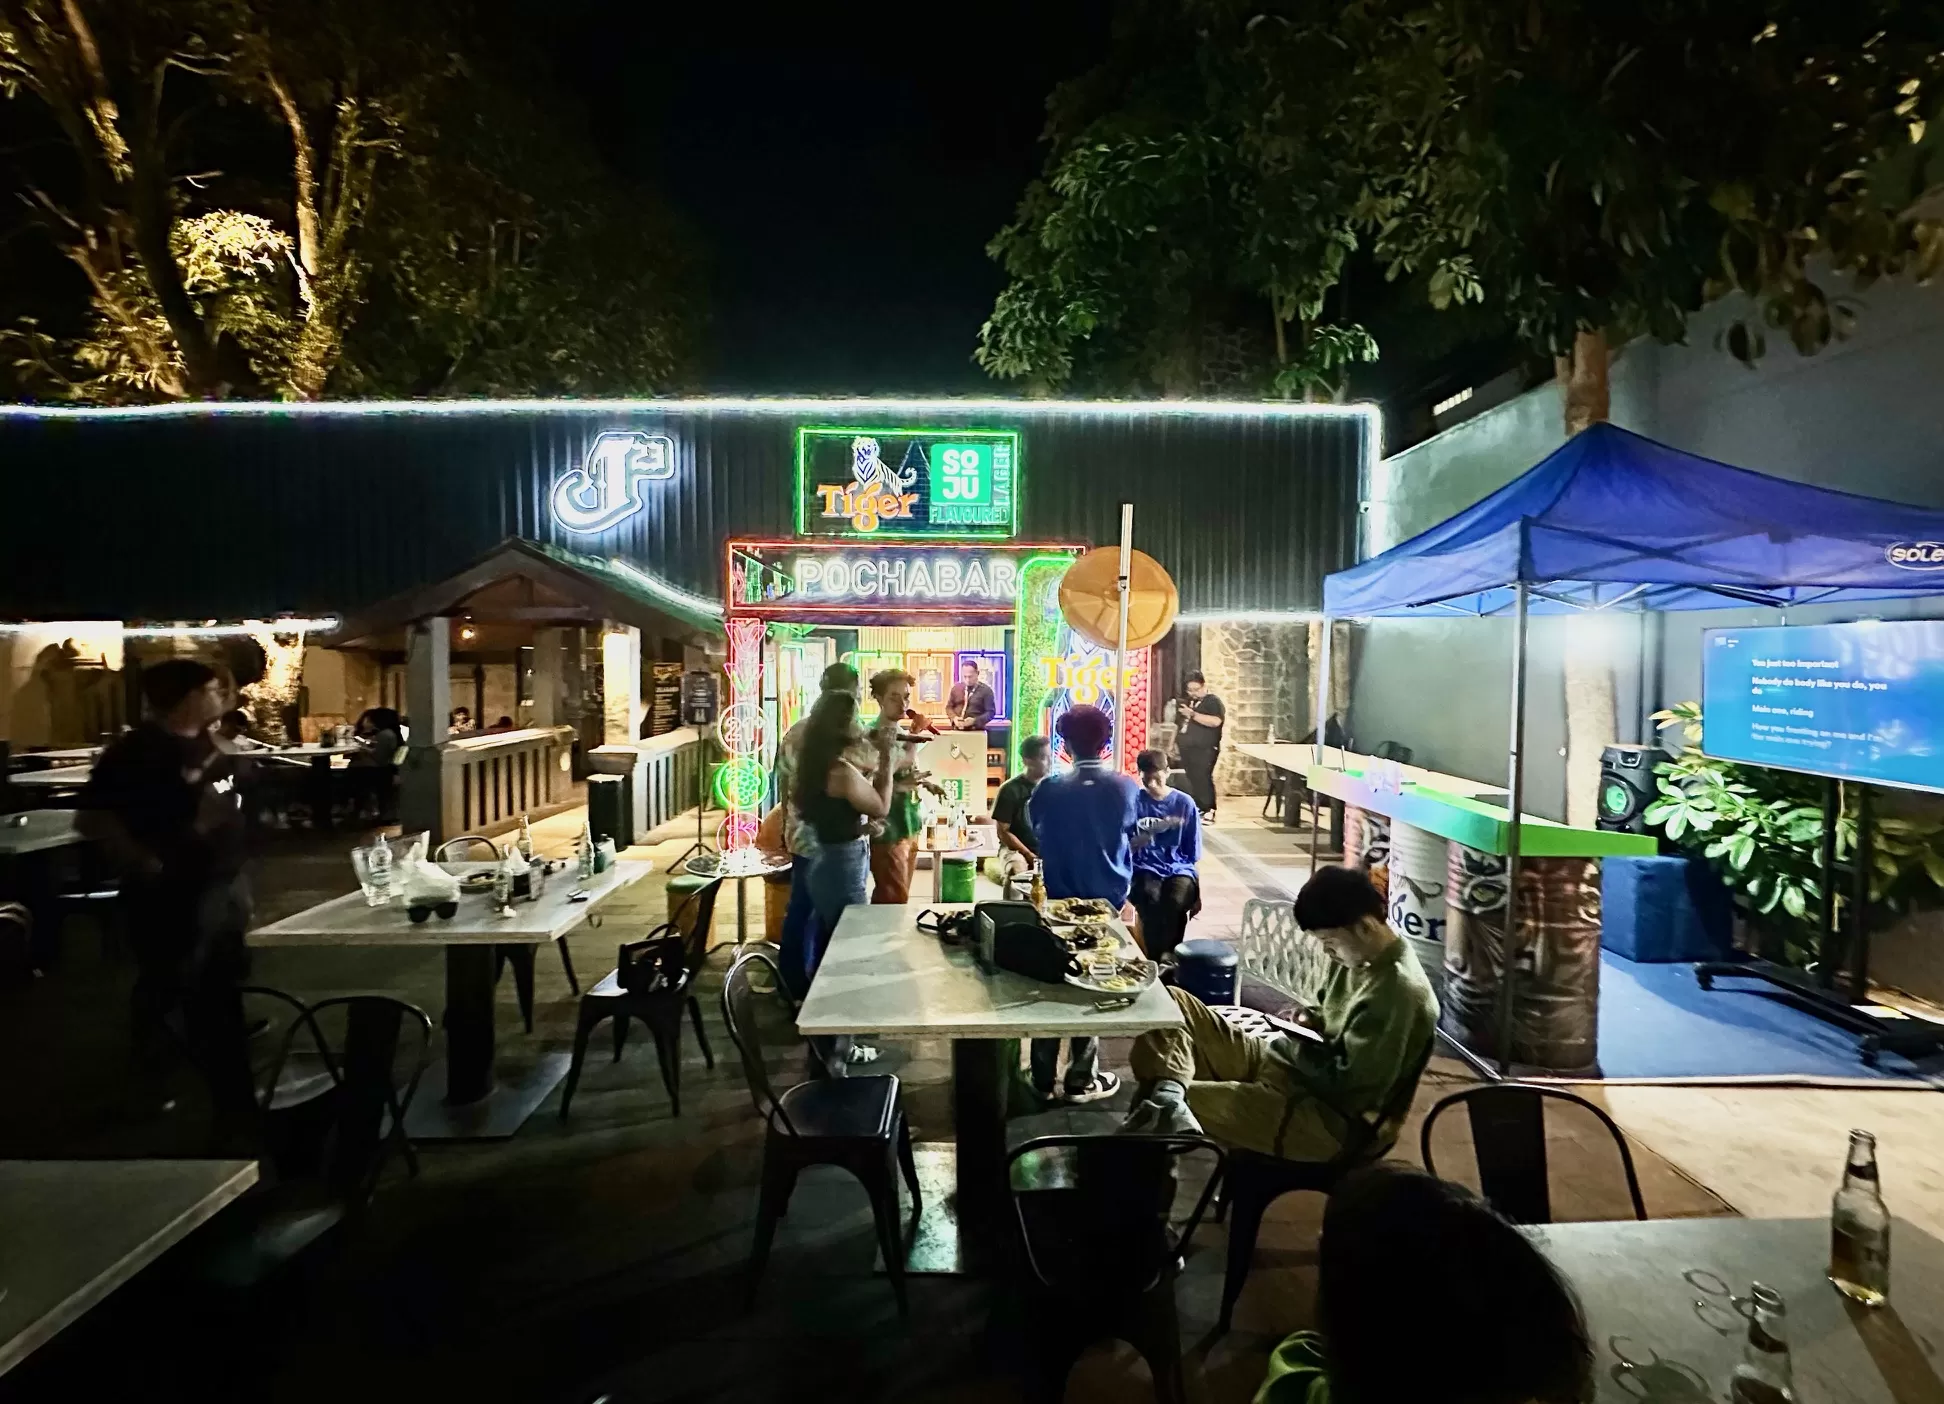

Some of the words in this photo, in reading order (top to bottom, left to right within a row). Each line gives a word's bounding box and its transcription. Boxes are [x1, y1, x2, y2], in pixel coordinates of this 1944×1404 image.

[942, 449, 979, 475] SO
[993, 442, 1011, 507] LAGER
[817, 481, 920, 532] Tiger
[942, 476, 979, 500] JU
[928, 505, 1011, 524] FLAVOURED
[795, 556, 1017, 598] POCHABAR
[1040, 653, 1140, 705] Tiger
